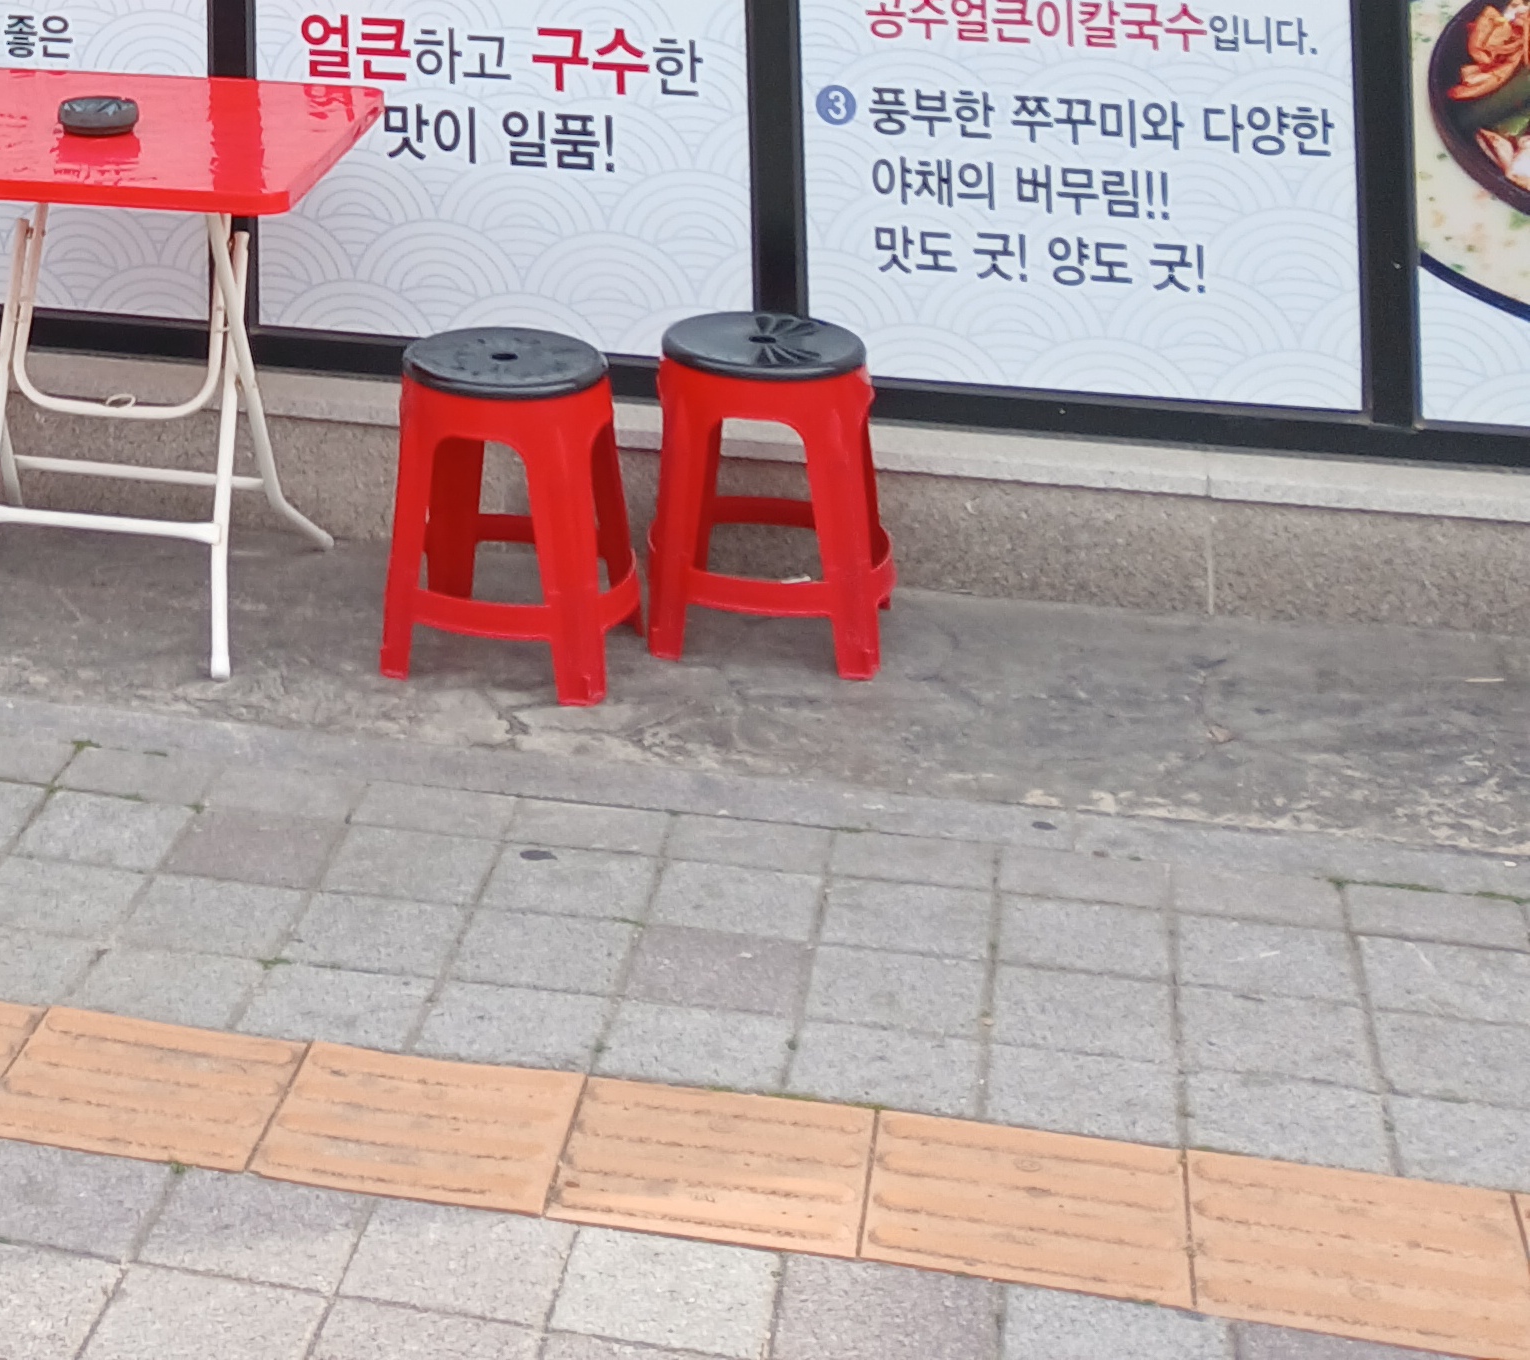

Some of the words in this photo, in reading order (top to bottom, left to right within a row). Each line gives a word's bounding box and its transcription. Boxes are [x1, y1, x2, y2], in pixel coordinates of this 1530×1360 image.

[4, 14, 74, 59] 좋은
[301, 14, 512, 84] 얼큰하고
[531, 26, 704, 98] 구수한
[382, 104, 478, 164] 맛이
[501, 109, 616, 173] 일품!
[869, 85, 995, 140] 풍부한
[1010, 93, 1184, 151] 쭈꾸미와
[1203, 103, 1334, 157] 다양한
[872, 156, 996, 210] 야채의
[1016, 164, 1170, 221] 버무림!!
[874, 226, 959, 275] 맛도
[972, 232, 1028, 279] 굿!
[1049, 236, 1134, 285] 양도
[1150, 242, 1208, 294] 굿!
